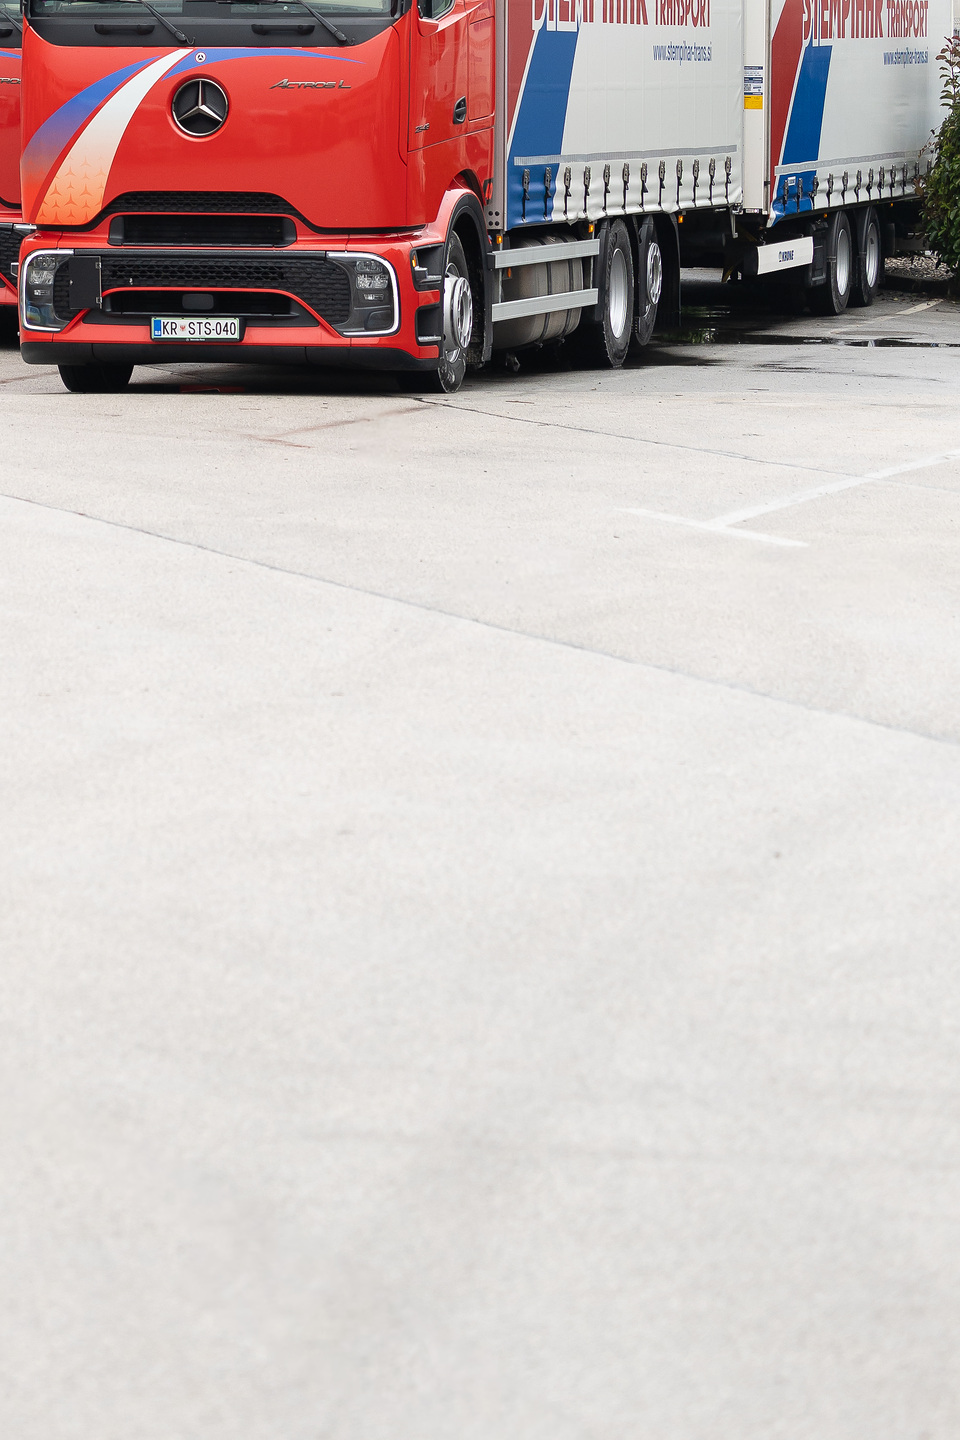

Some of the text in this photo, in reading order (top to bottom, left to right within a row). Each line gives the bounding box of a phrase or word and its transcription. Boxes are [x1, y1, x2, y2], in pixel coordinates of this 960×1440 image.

[886, 0, 929, 38] TRANSPORT
[652, 40, 713, 66] www.stempihar-trans.si
[338, 79, 352, 90] L
[162, 321, 237, 337] KR STS-040
